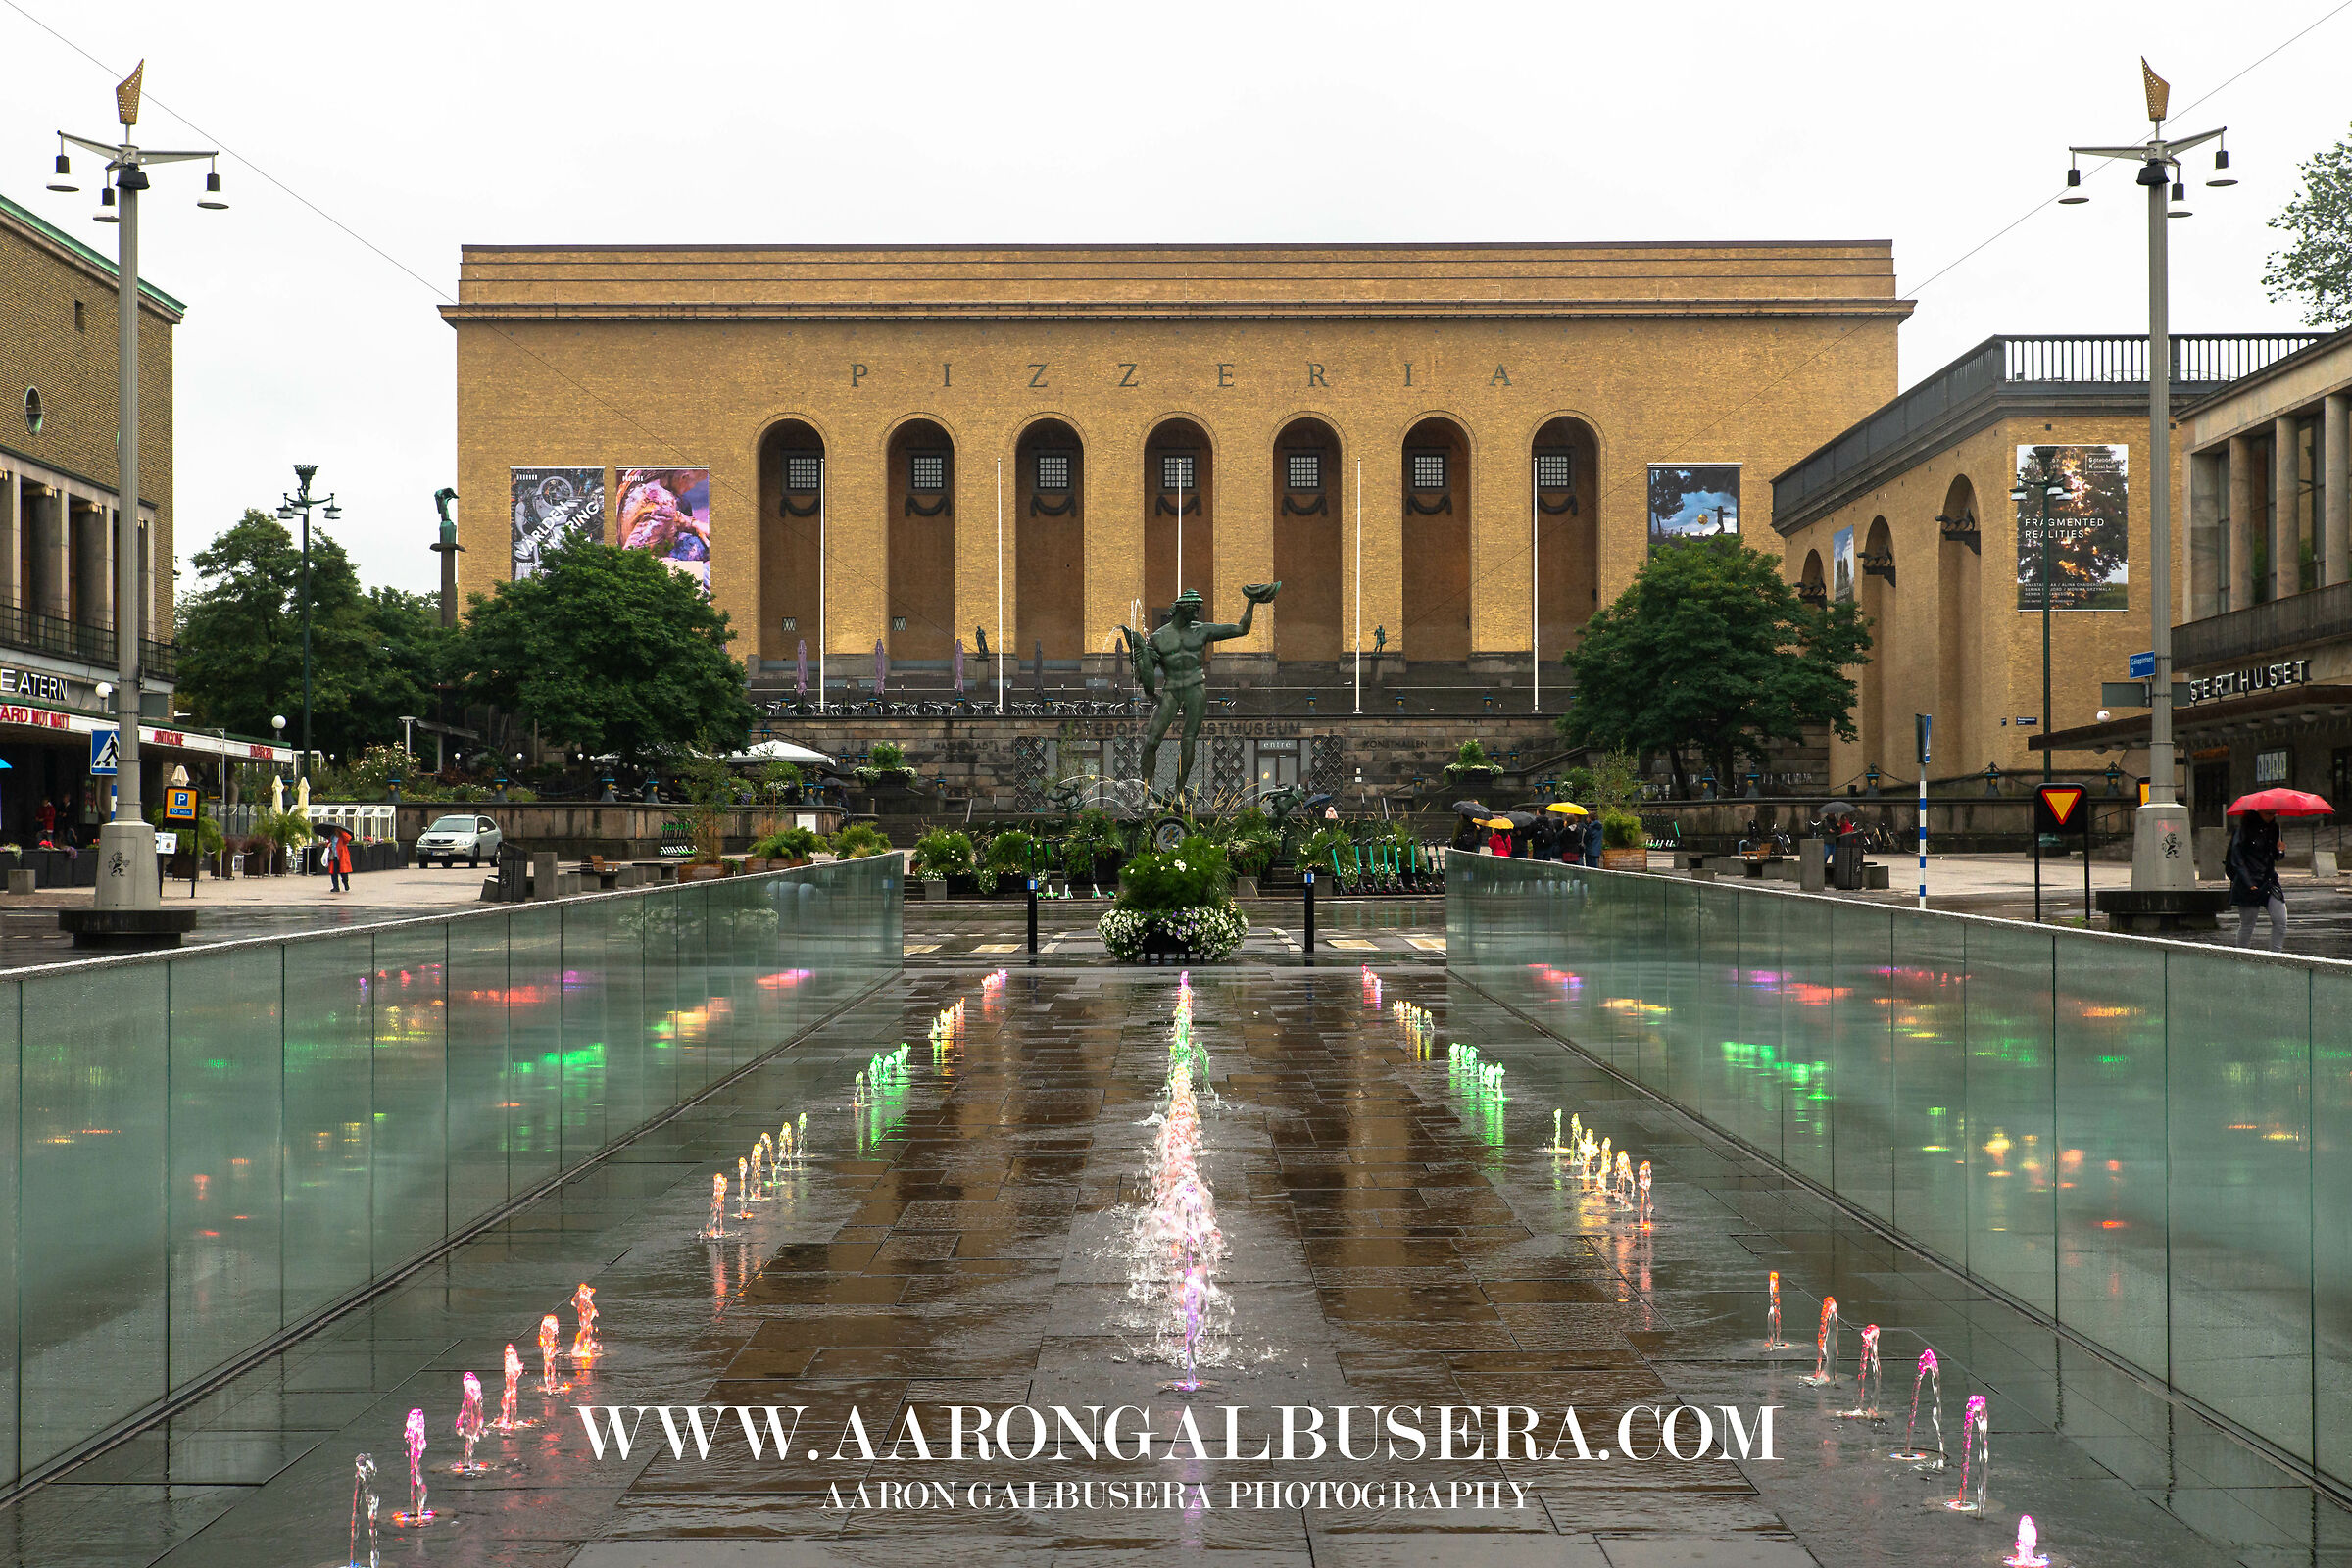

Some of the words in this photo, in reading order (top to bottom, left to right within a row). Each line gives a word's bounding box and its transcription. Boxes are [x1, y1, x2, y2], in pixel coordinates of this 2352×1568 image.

[851, 363, 1513, 389] PIZZERIA
[515, 501, 569, 557] VÄRLDEN
[177, 794, 186, 805] P
